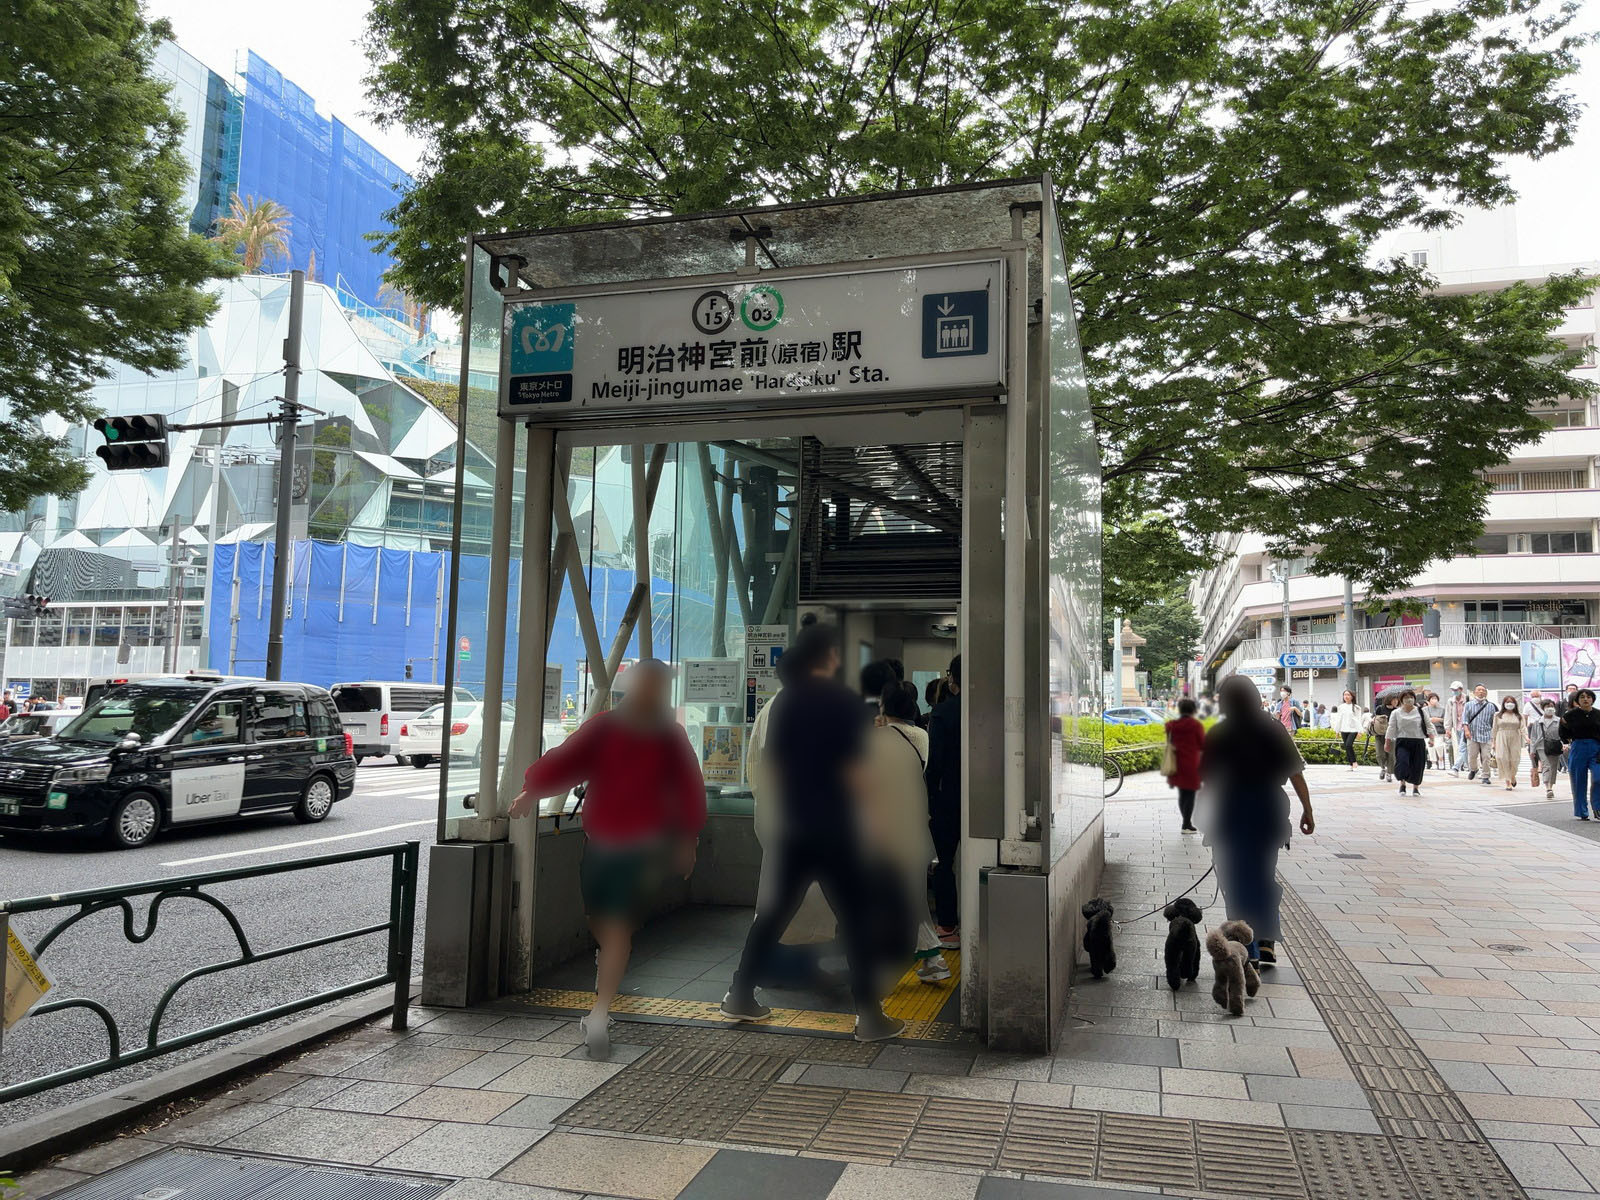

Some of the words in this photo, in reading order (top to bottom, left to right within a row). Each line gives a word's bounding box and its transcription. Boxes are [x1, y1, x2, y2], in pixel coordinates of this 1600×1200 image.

[710, 298, 718, 310] F
[704, 312, 723, 326] 15
[751, 308, 773, 323] 03
[519, 380, 563, 391] 東京メトロ
[592, 377, 743, 402] Meiji-jingumae
[849, 366, 890, 384] Sta.
[185, 792, 211, 805] Uber
